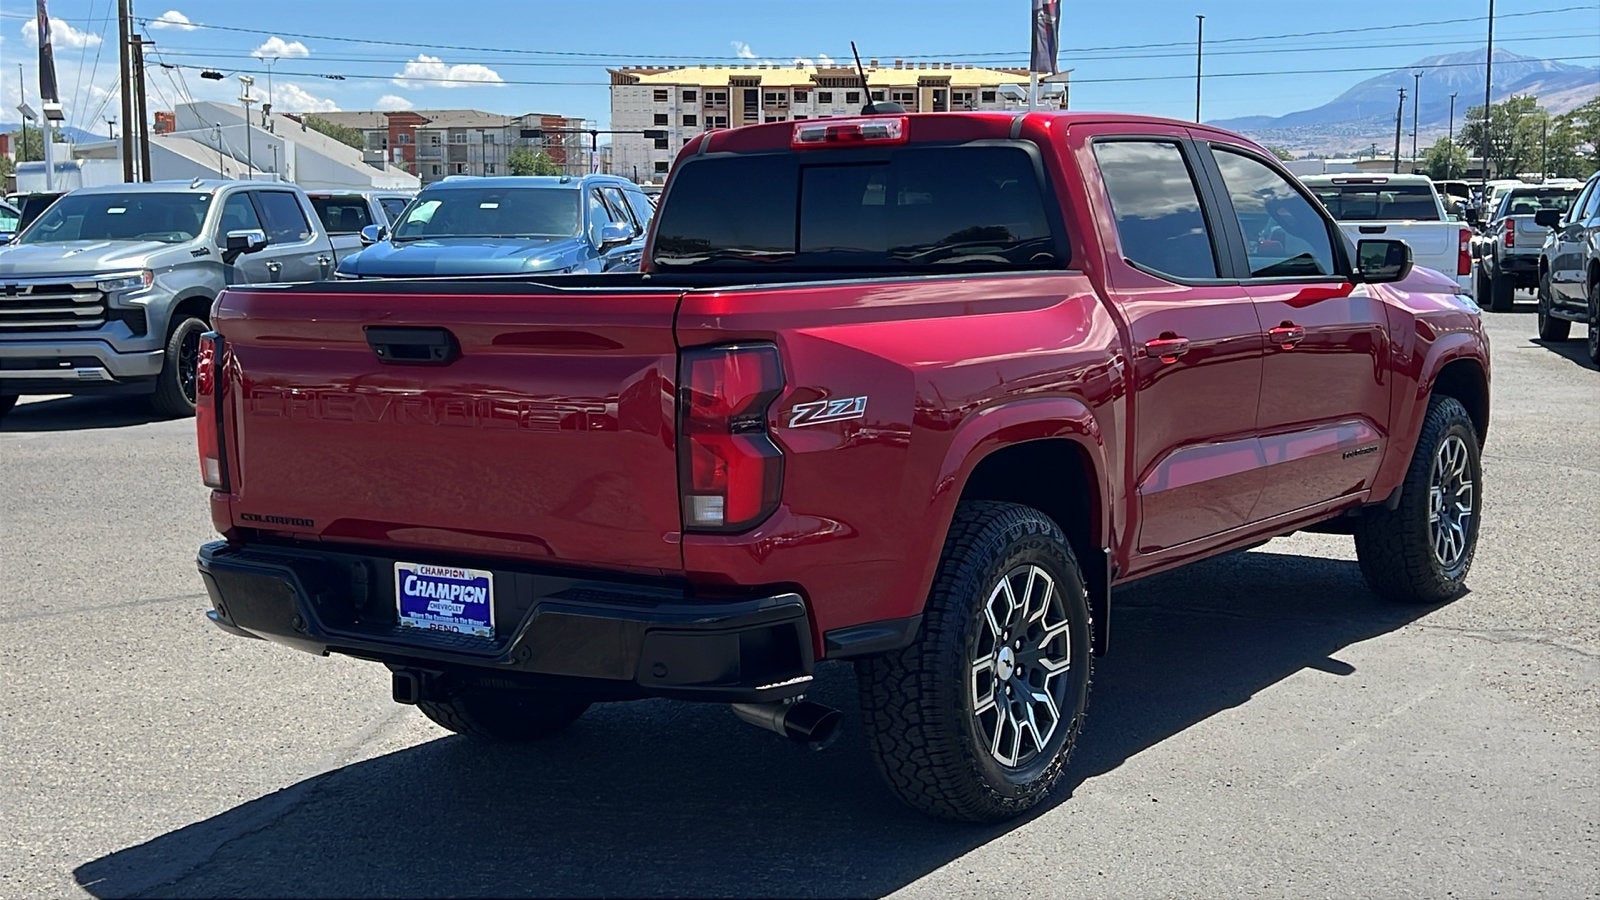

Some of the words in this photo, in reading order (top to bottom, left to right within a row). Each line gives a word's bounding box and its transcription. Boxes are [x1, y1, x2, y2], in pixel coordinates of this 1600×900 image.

[250, 389, 607, 433] CHEVROLET
[789, 396, 868, 428] Z71
[240, 513, 315, 528] COLORADO
[420, 566, 465, 579] CHAMPION
[429, 602, 462, 613] CHEVROLET
